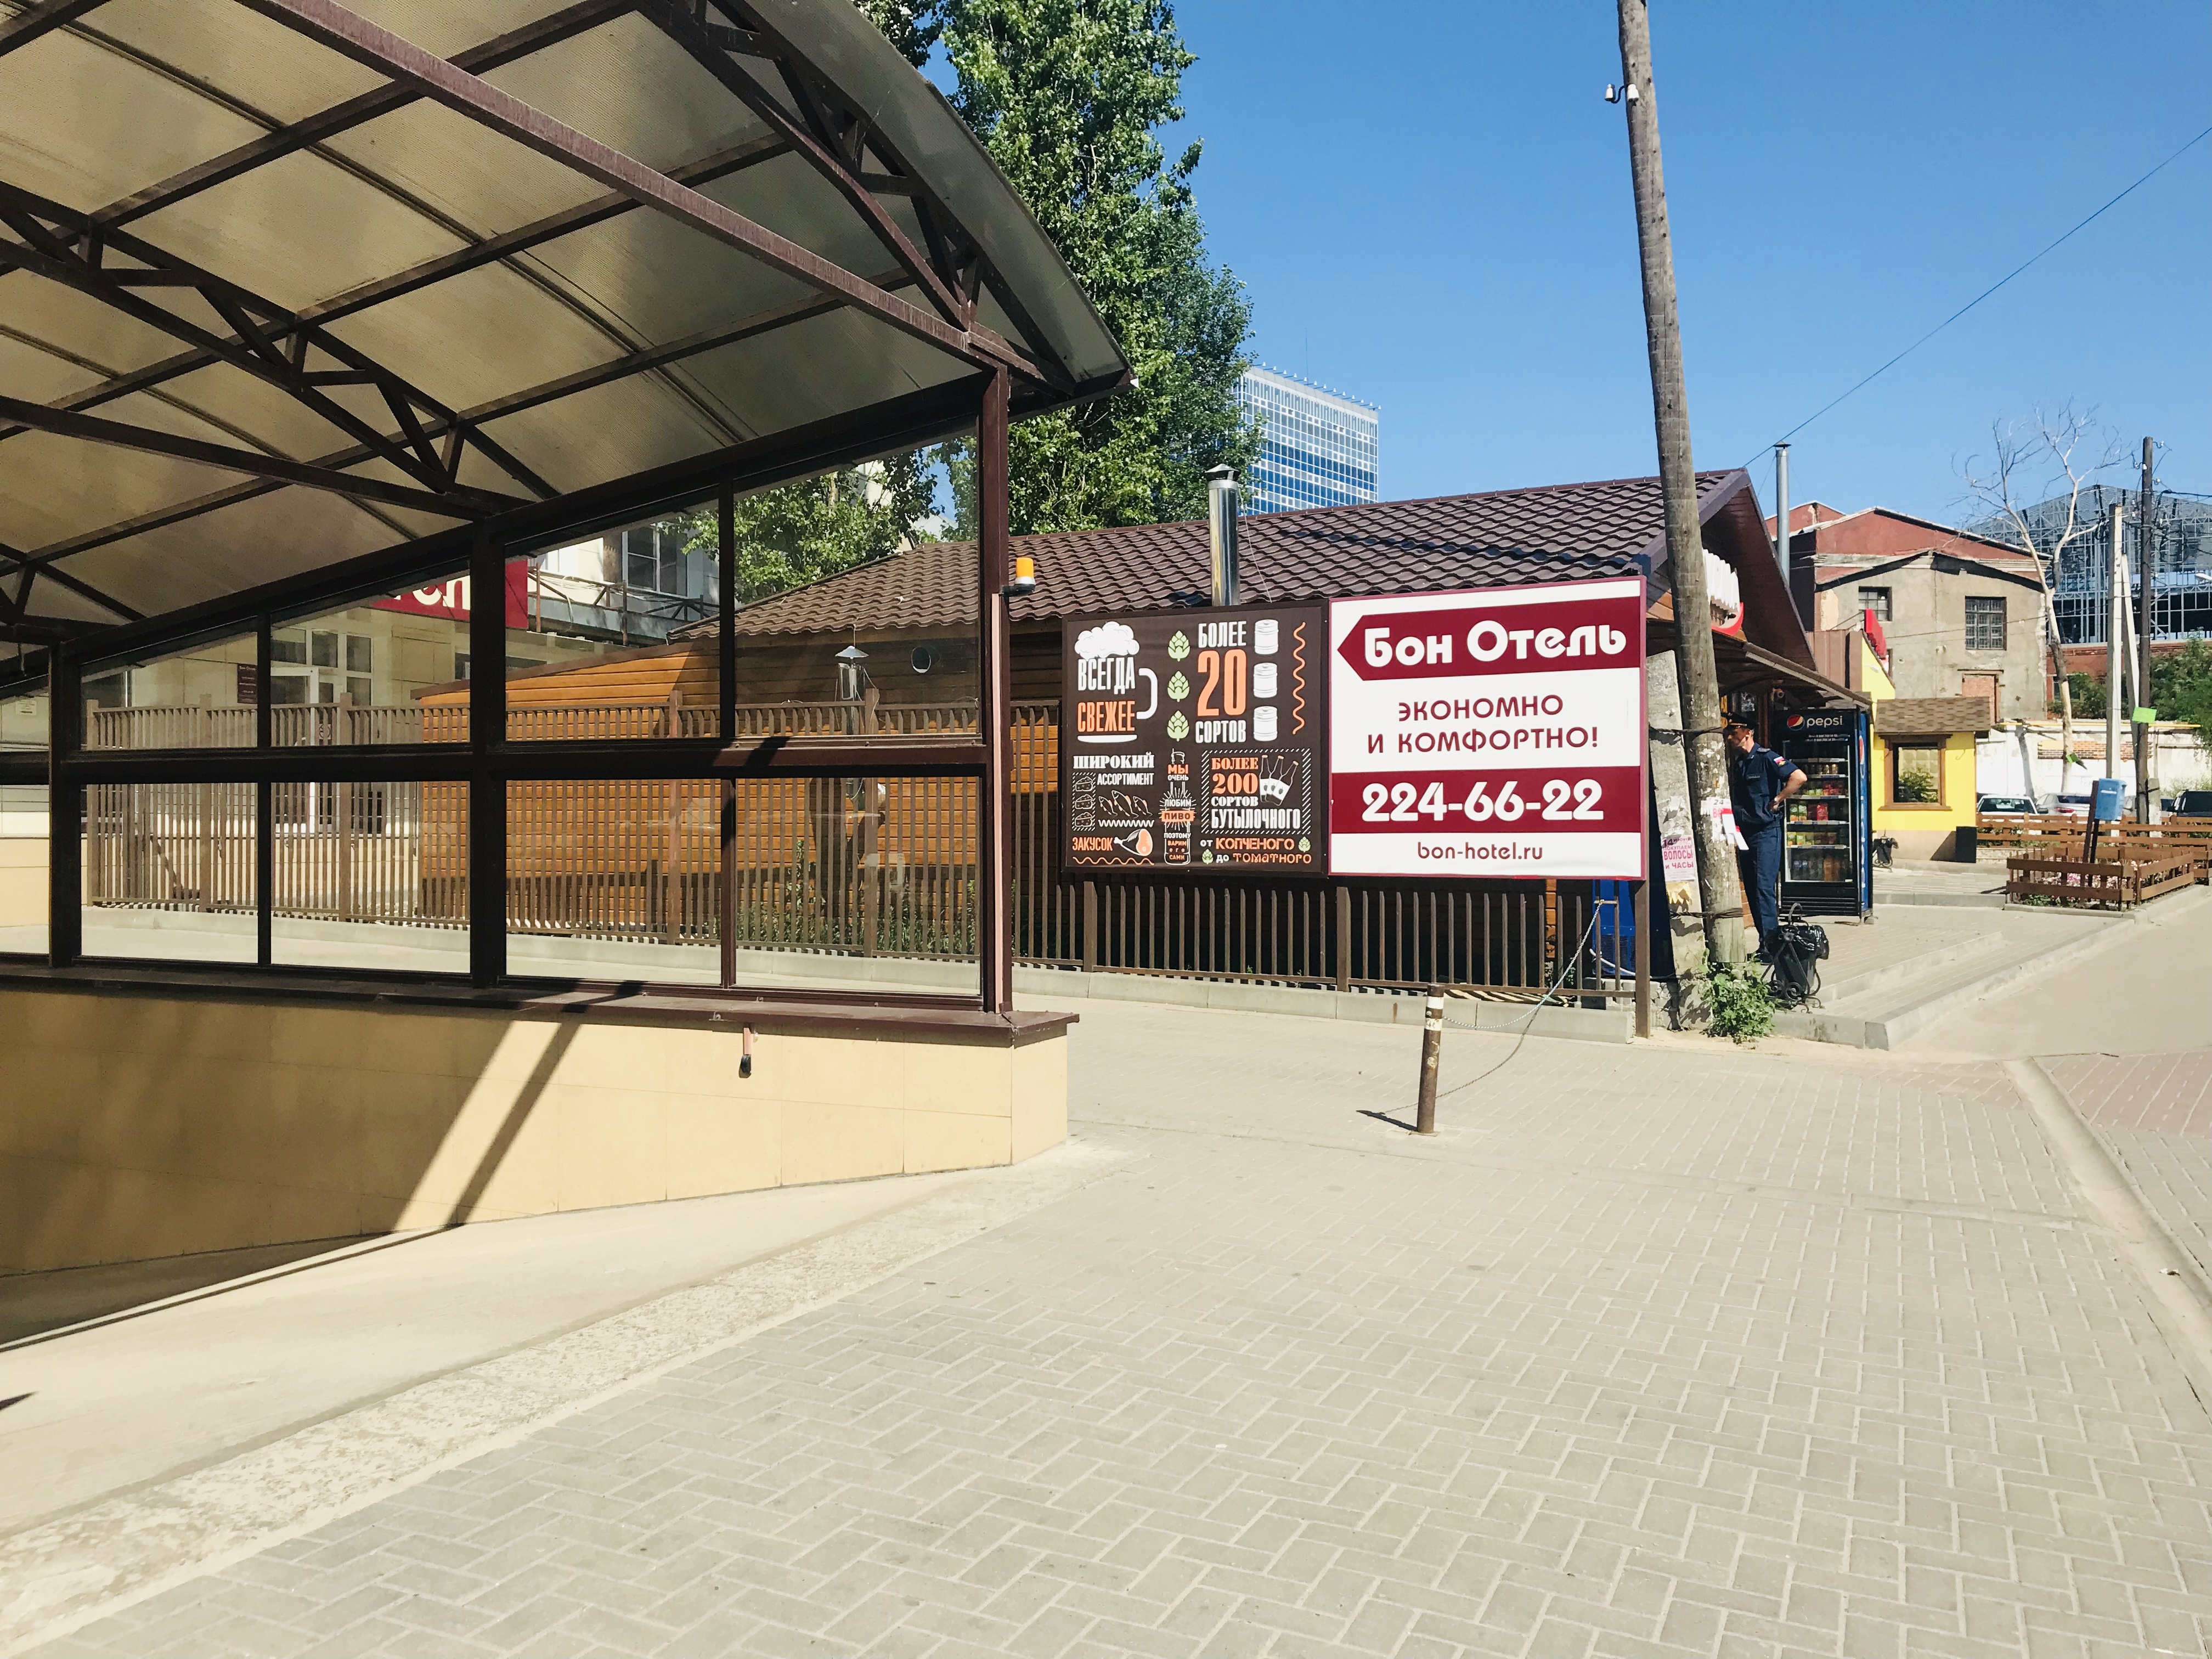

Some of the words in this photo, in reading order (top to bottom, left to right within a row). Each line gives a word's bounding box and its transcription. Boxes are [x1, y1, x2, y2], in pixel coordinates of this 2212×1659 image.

[1198, 620, 1247, 648] БОЛЕЕ
[1364, 627, 1453, 668] Бон
[1466, 620, 1627, 662] Отель
[1077, 657, 1136, 695] ВСЕГДА
[1197, 649, 1248, 717] 20
[1077, 701, 1136, 733] СВЕЖЕЕ
[1398, 694, 1564, 722] ЭКОНОМНО
[1807, 715, 1843, 729] pepsi
[1195, 720, 1246, 744] СОРТОВ
[1367, 733, 1384, 754] И
[1398, 726, 1598, 753] КОМФОРТНО!
[1073, 751, 1155, 769] ШИРОКИЙ
[1167, 764, 1189, 774] МЫ
[1211, 757, 1259, 770] БОЛЕЕ
[1097, 773, 1154, 786] АССОРТИМЕНТ
[1212, 772, 1259, 794] 200
[1164, 799, 1192, 807] ЛЮБИМ
[1211, 796, 1259, 806] СОРТОВ
[1362, 778, 1604, 822] 224-66-22
[1211, 809, 1301, 829] БУТЫЛОЧНОГО
[1072, 837, 1113, 851] ЗАКУСОК
[1216, 838, 1295, 850] КОПЧЕНОГО
[1417, 842, 1543, 860] bon-hotel.ru
[1662, 838, 1674, 848] 14
[1216, 854, 1229, 863] до
[1663, 849, 1693, 860] ВОЛОСЫ
